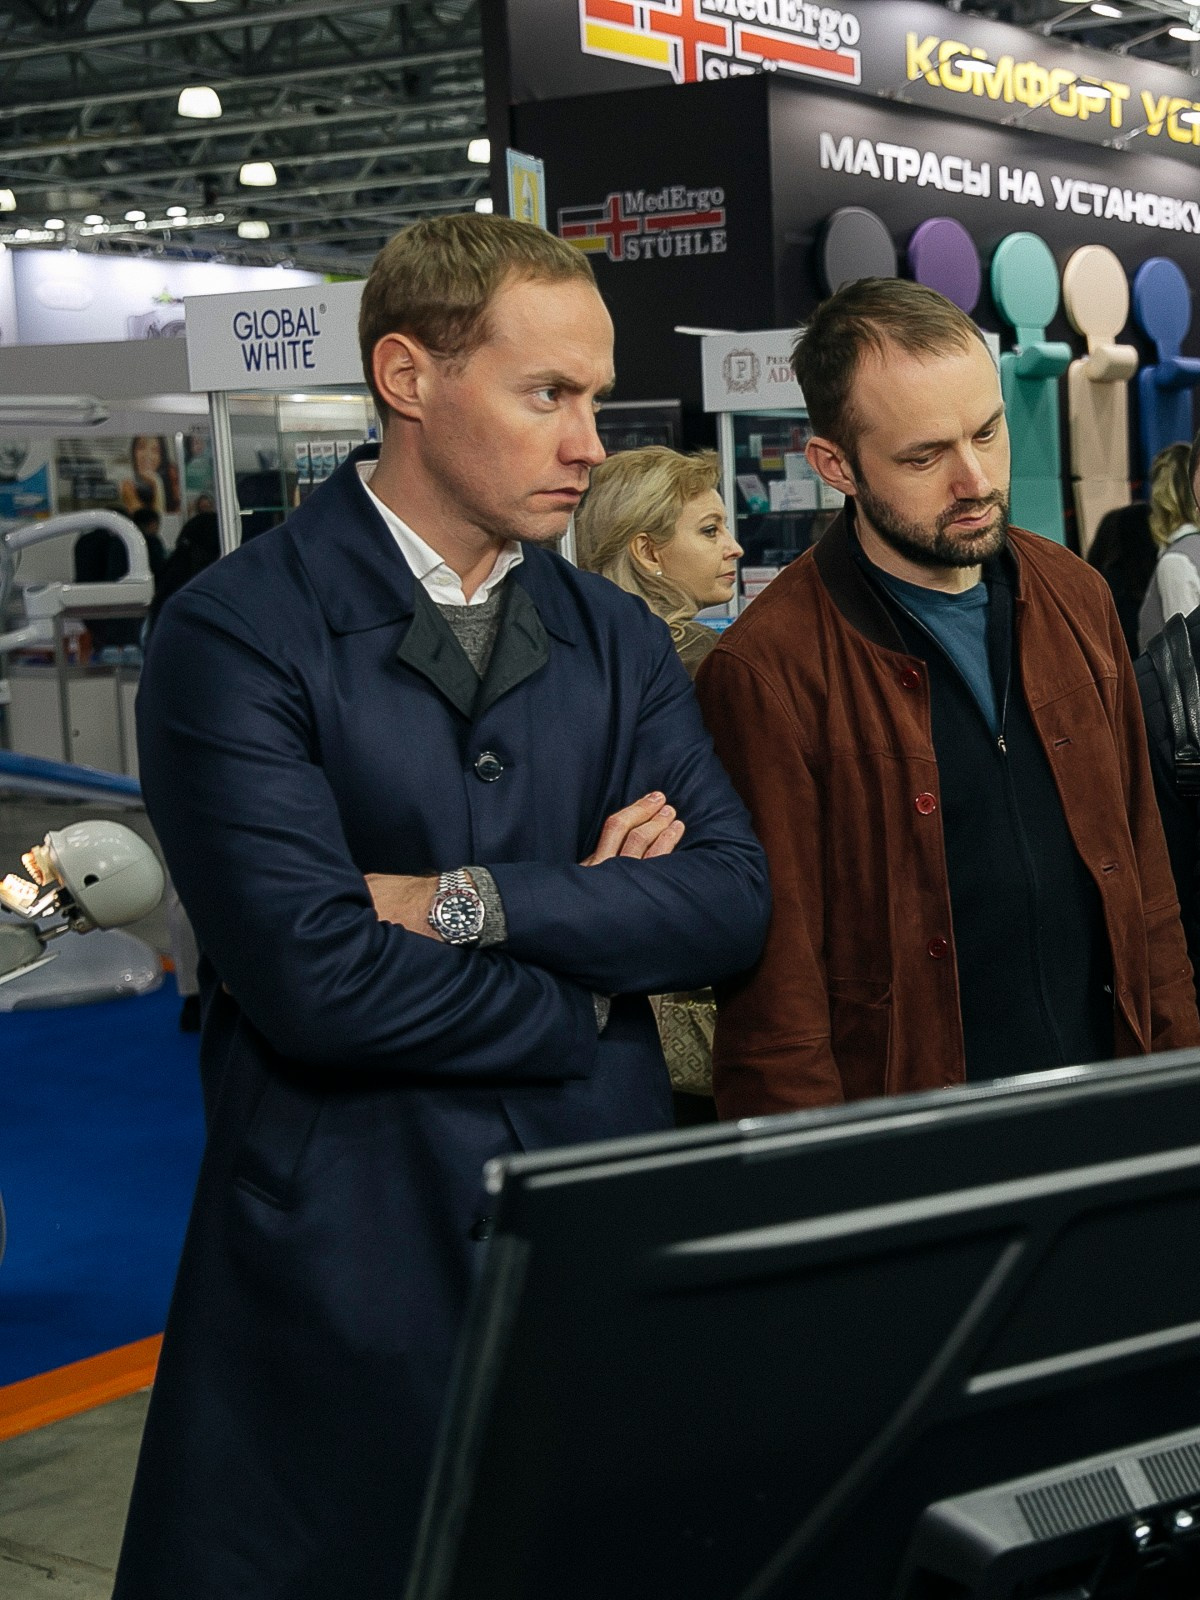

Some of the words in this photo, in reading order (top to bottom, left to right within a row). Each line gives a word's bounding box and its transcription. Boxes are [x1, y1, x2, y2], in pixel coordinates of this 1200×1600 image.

[906, 31, 1131, 128] КОМФОРТ
[819, 132, 991, 198] МАТРАСЫ
[998, 165, 1044, 207] НА
[624, 185, 725, 213] MedErgo
[625, 229, 728, 261] STÜHLE
[233, 306, 321, 340] GLOBAL
[241, 339, 316, 372] WHITE
